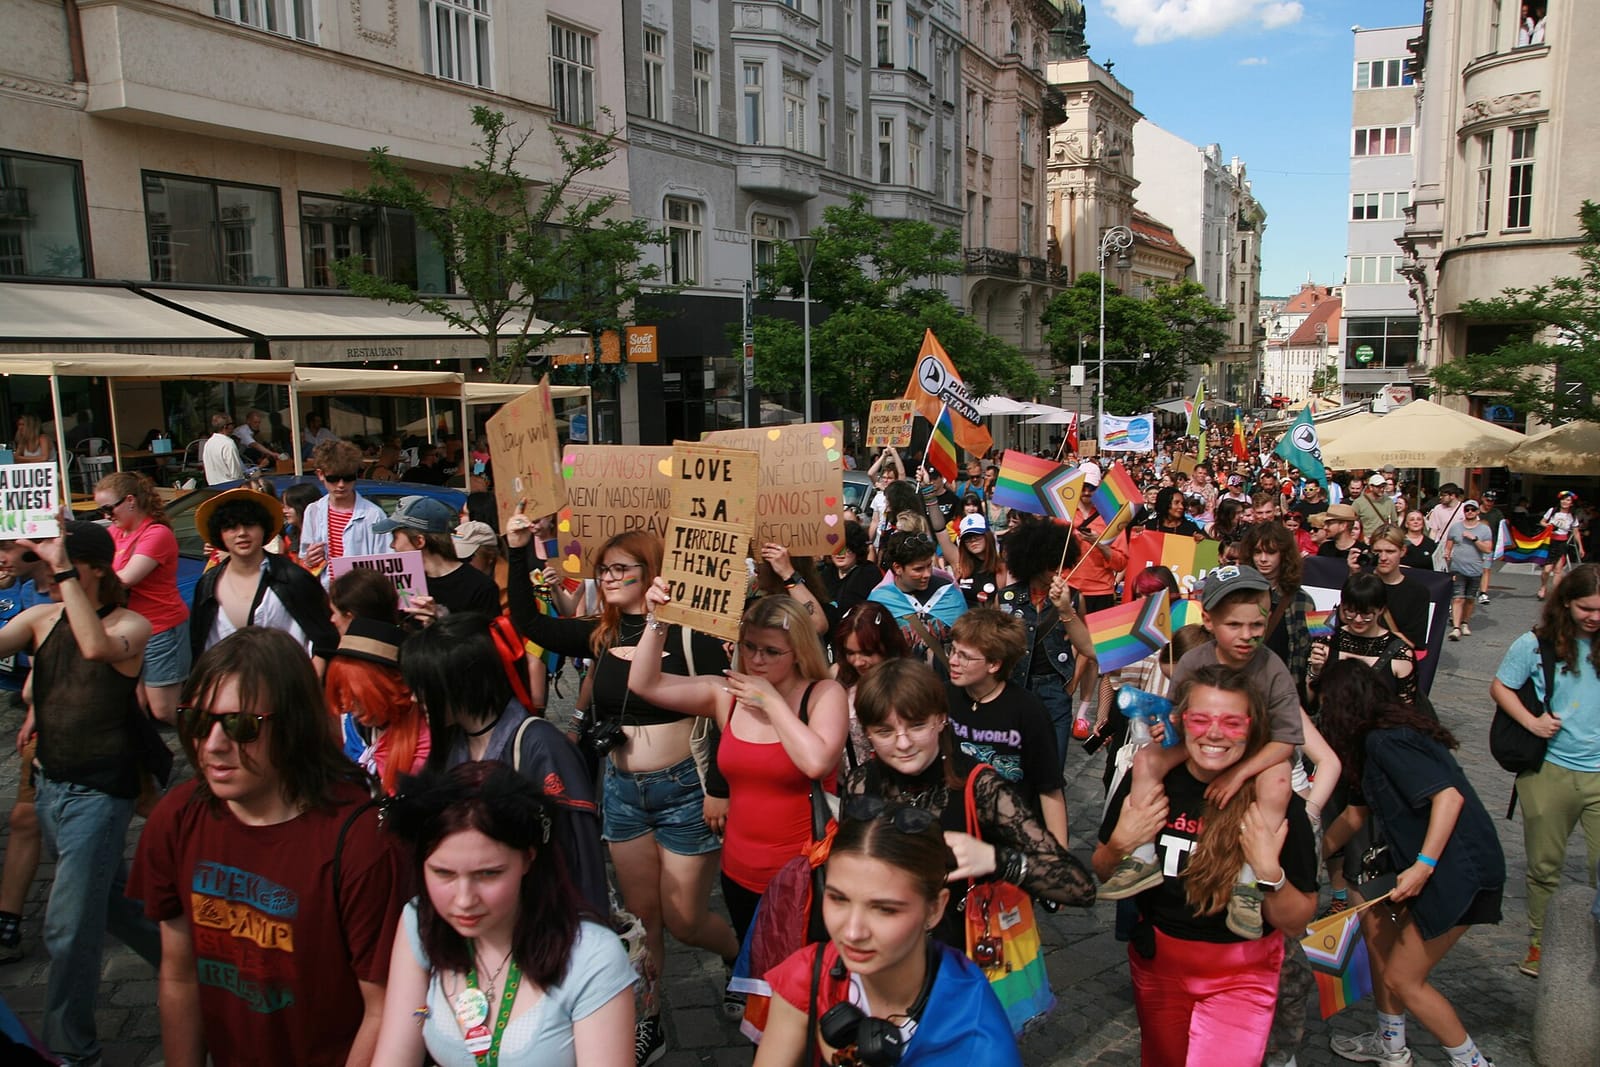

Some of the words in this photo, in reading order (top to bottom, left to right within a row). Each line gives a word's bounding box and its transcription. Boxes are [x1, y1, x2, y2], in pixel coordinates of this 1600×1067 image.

[347, 347, 404, 358] RESTAURANT
[941, 392, 981, 424] STRANA
[774, 431, 818, 458] JSME
[12, 468, 52, 488] ULICE
[574, 453, 656, 480] ROVNOST
[682, 458, 732, 482] LOVE
[6, 490, 51, 510] KVEST
[567, 483, 602, 508] NENÍ
[690, 497, 706, 518] IS
[713, 499, 727, 522] A
[571, 514, 593, 538] JE
[597, 515, 617, 538] TO
[675, 527, 739, 555] TERRIBLE
[672, 550, 731, 582] THING
[668, 580, 686, 601] TO
[690, 584, 731, 614] HATE
